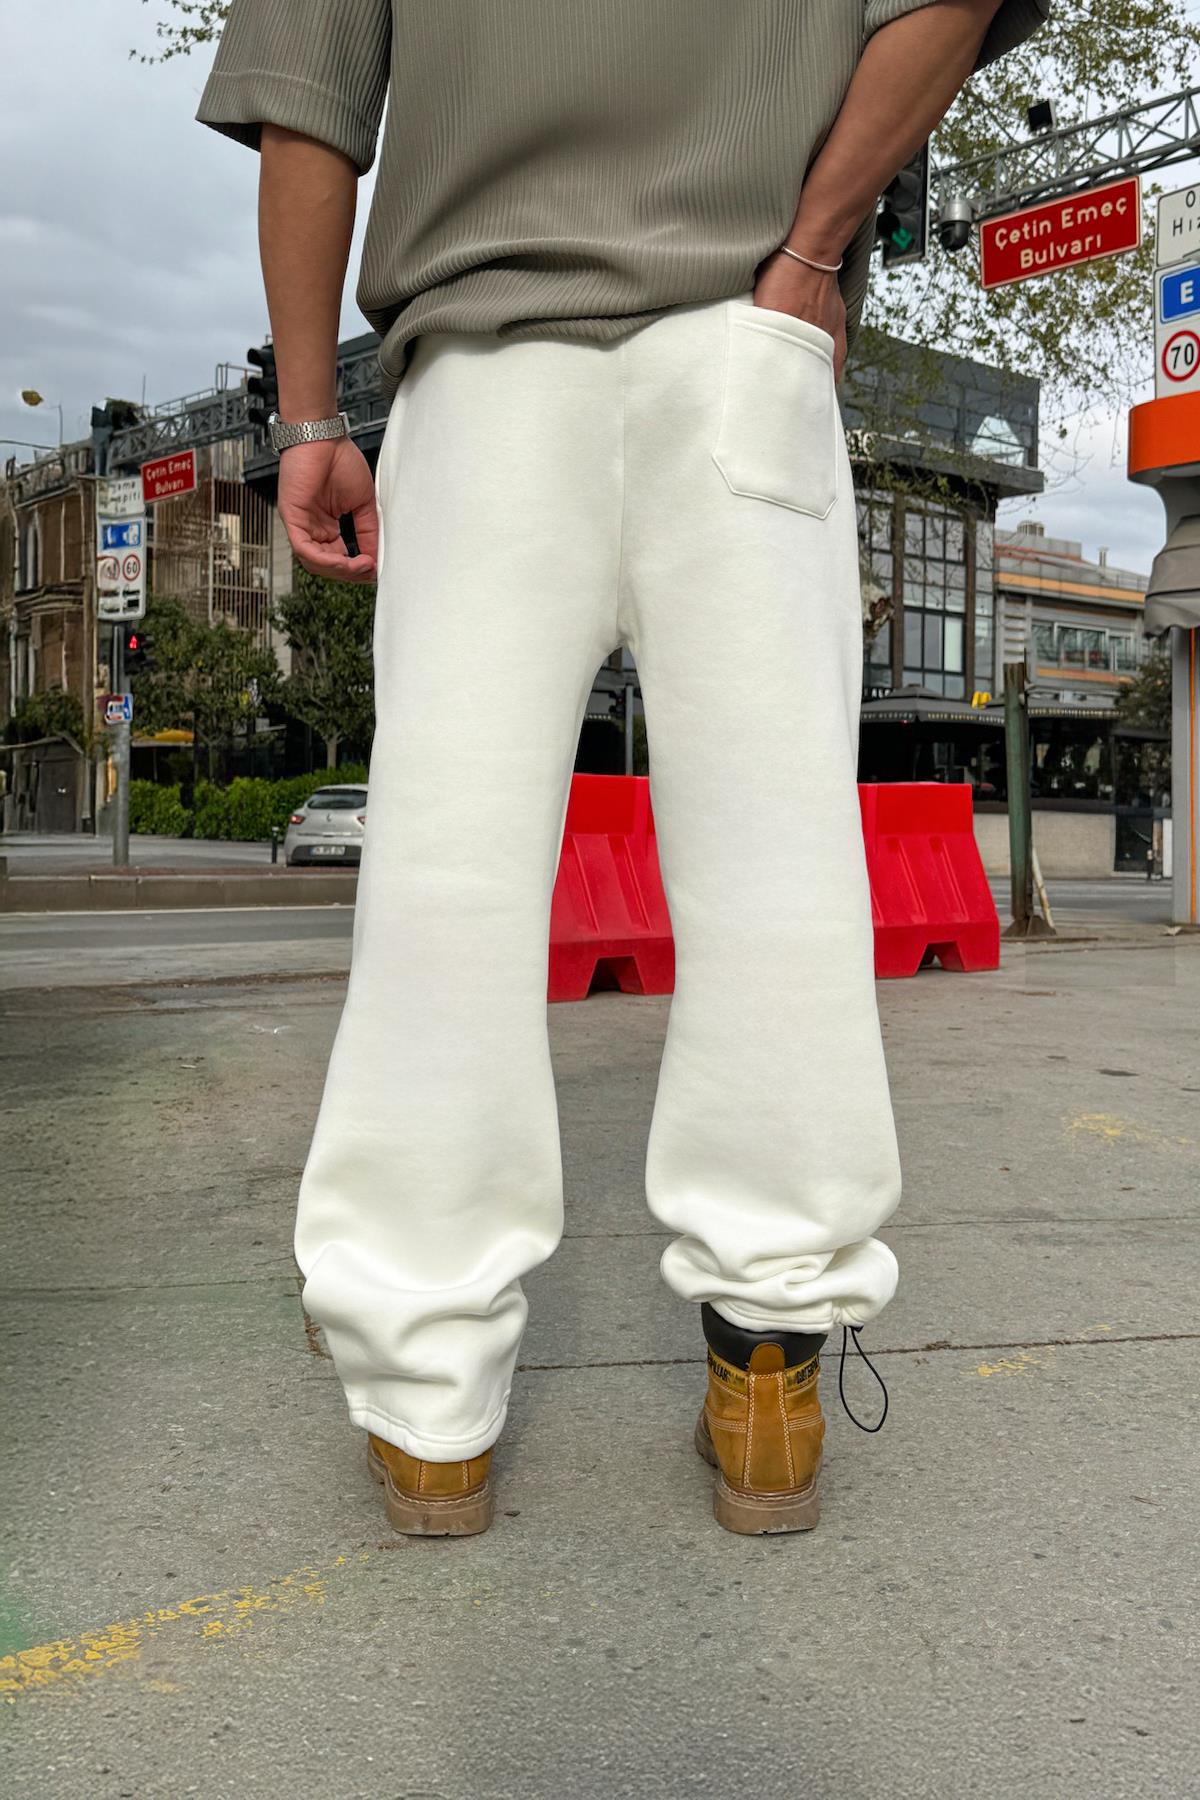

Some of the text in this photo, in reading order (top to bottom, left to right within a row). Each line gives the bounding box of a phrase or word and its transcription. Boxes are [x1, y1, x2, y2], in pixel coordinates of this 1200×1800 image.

[995, 197, 1128, 250] Çetin Emeç
[1020, 234, 1101, 269] Bulvarı
[1180, 280, 1194, 304] E
[1170, 343, 1194, 370] 70
[126, 560, 138, 575] 60
